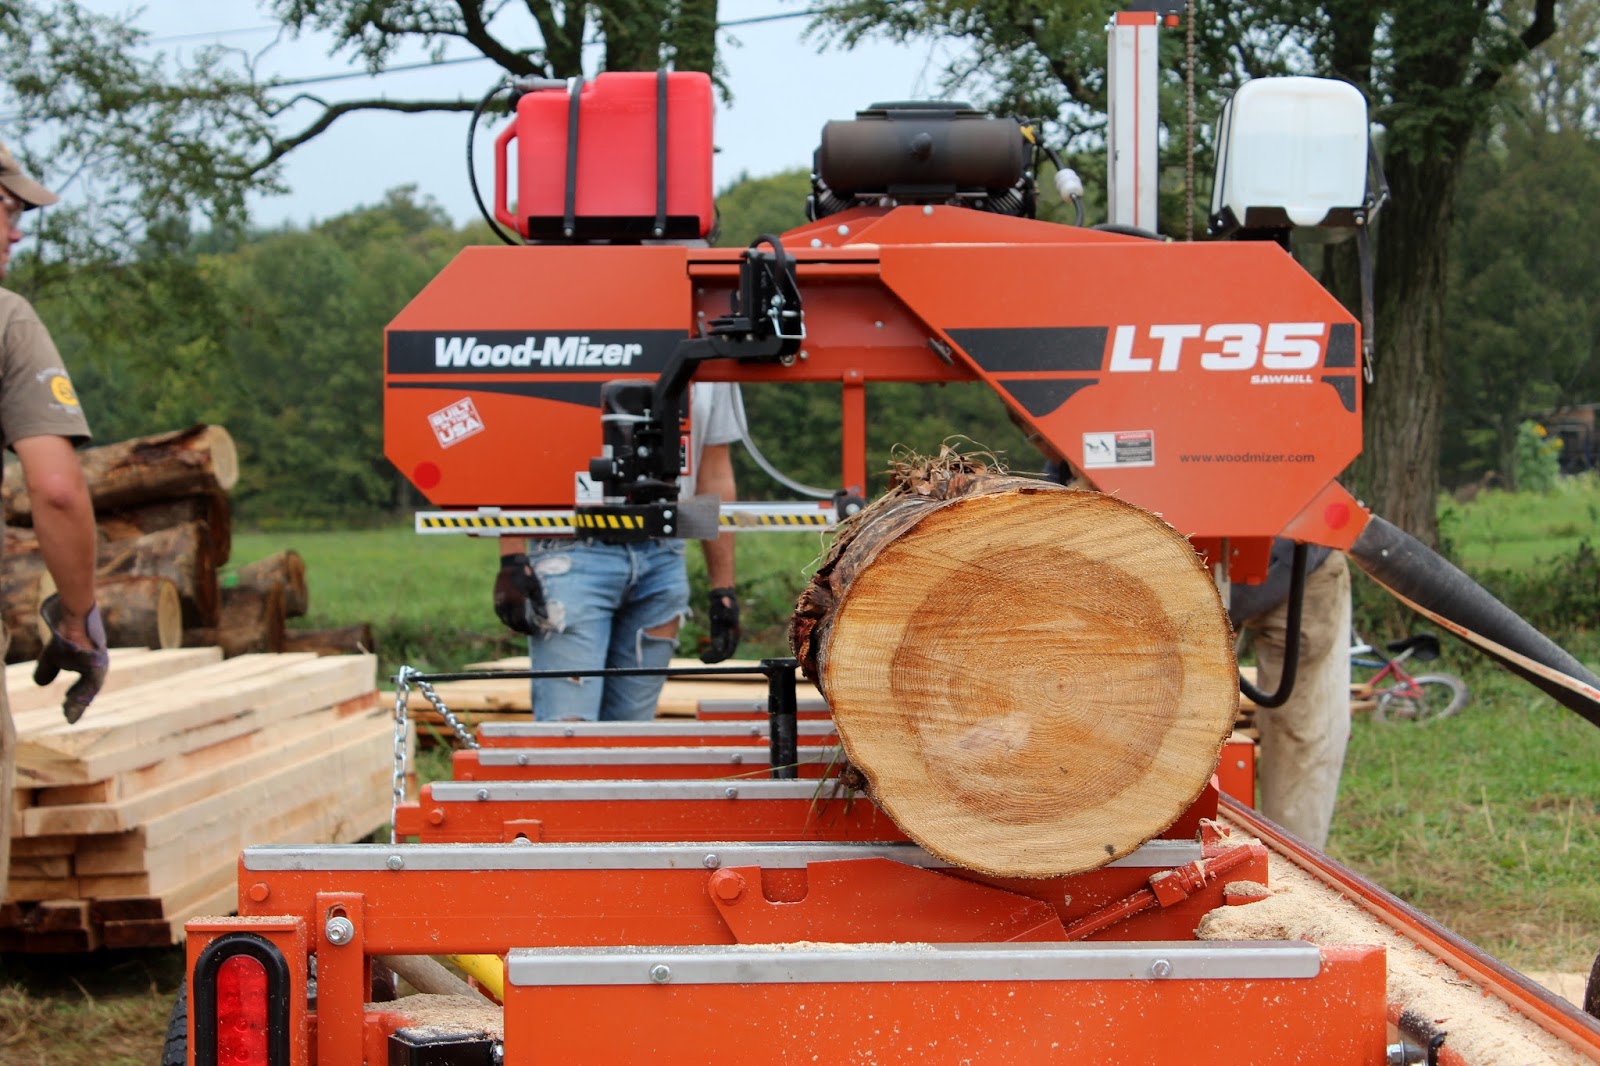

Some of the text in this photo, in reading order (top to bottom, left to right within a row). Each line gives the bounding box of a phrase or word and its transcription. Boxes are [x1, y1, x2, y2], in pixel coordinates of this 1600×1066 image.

[434, 335, 642, 368] Wood-Mizer
[1108, 322, 1326, 373] LT35
[1250, 374, 1314, 385] SAWMILL
[432, 400, 469, 425] BUILT
[439, 418, 480, 442] USA
[1180, 453, 1316, 464] www.woodmizer.com
